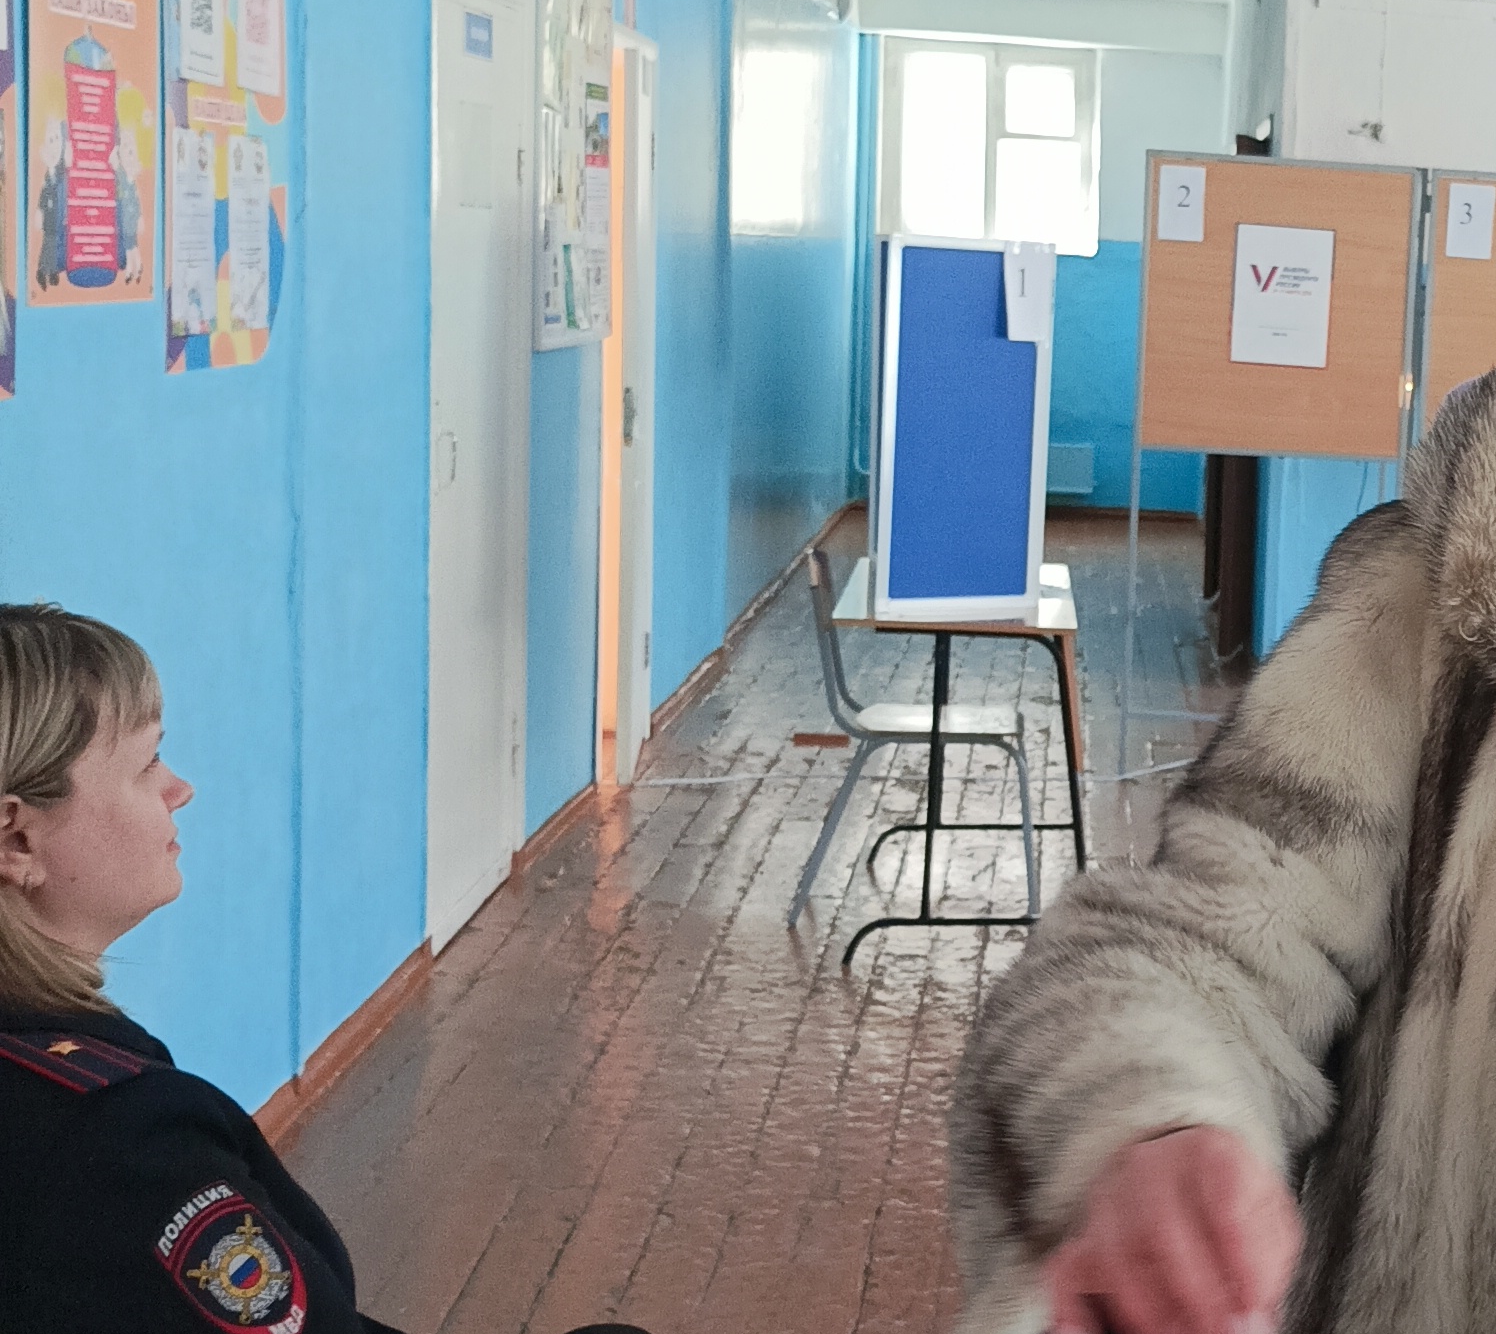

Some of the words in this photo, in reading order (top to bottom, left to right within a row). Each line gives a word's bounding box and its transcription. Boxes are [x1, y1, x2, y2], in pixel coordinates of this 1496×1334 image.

[1176, 184, 1191, 208] 2
[1459, 202, 1473, 225] 3
[1018, 268, 1026, 298] 1
[157, 1184, 234, 1257] ПОЛИЦИЯ
